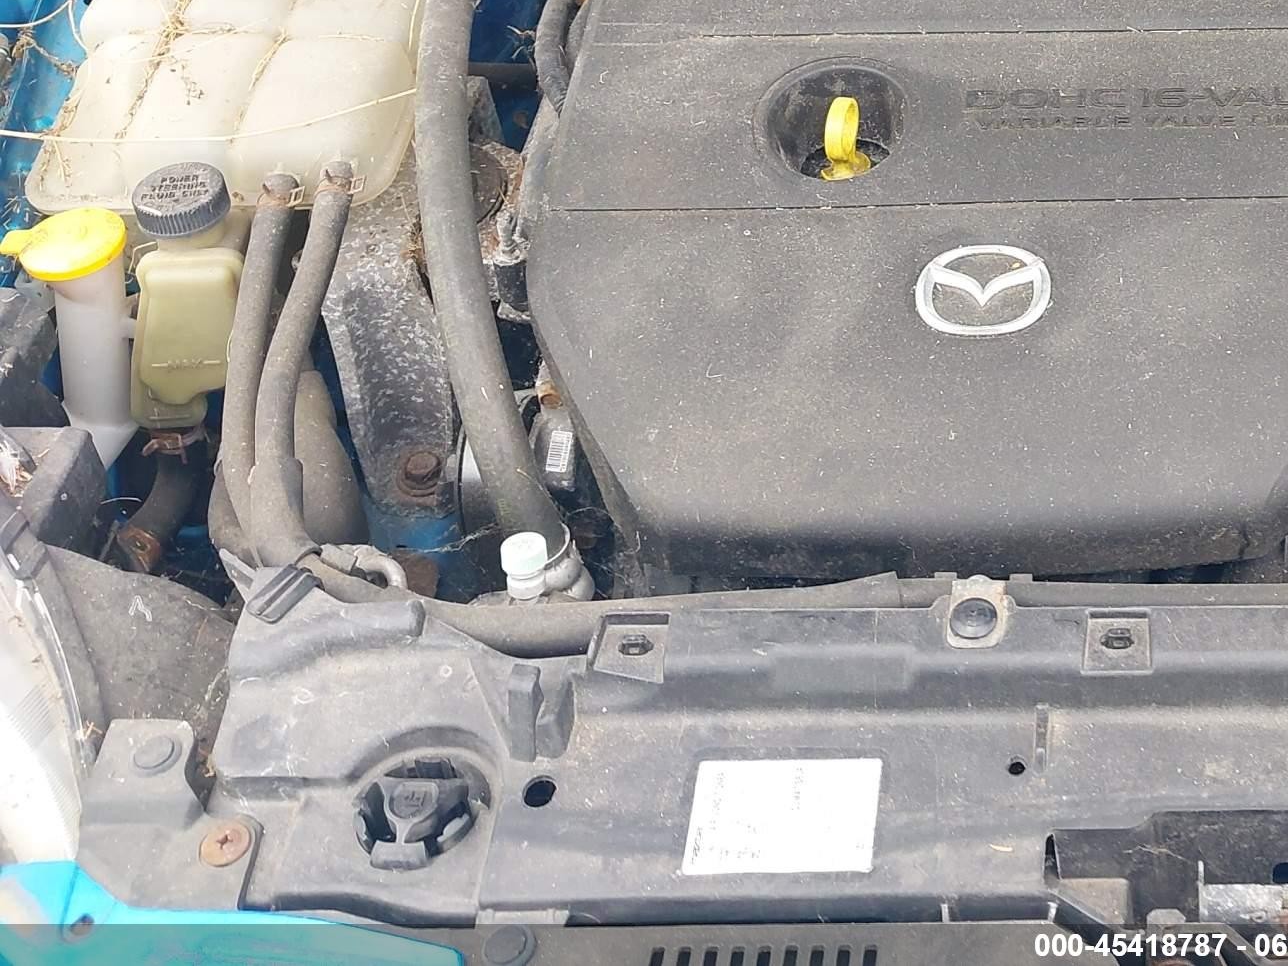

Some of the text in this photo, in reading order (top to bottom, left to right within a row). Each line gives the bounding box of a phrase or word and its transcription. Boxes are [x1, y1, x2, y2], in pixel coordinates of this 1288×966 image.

[965, 87, 1127, 110] DOHC
[976, 115, 1132, 130] VARIABLE
[1142, 114, 1236, 129] VALVE
[160, 174, 200, 184] POWER
